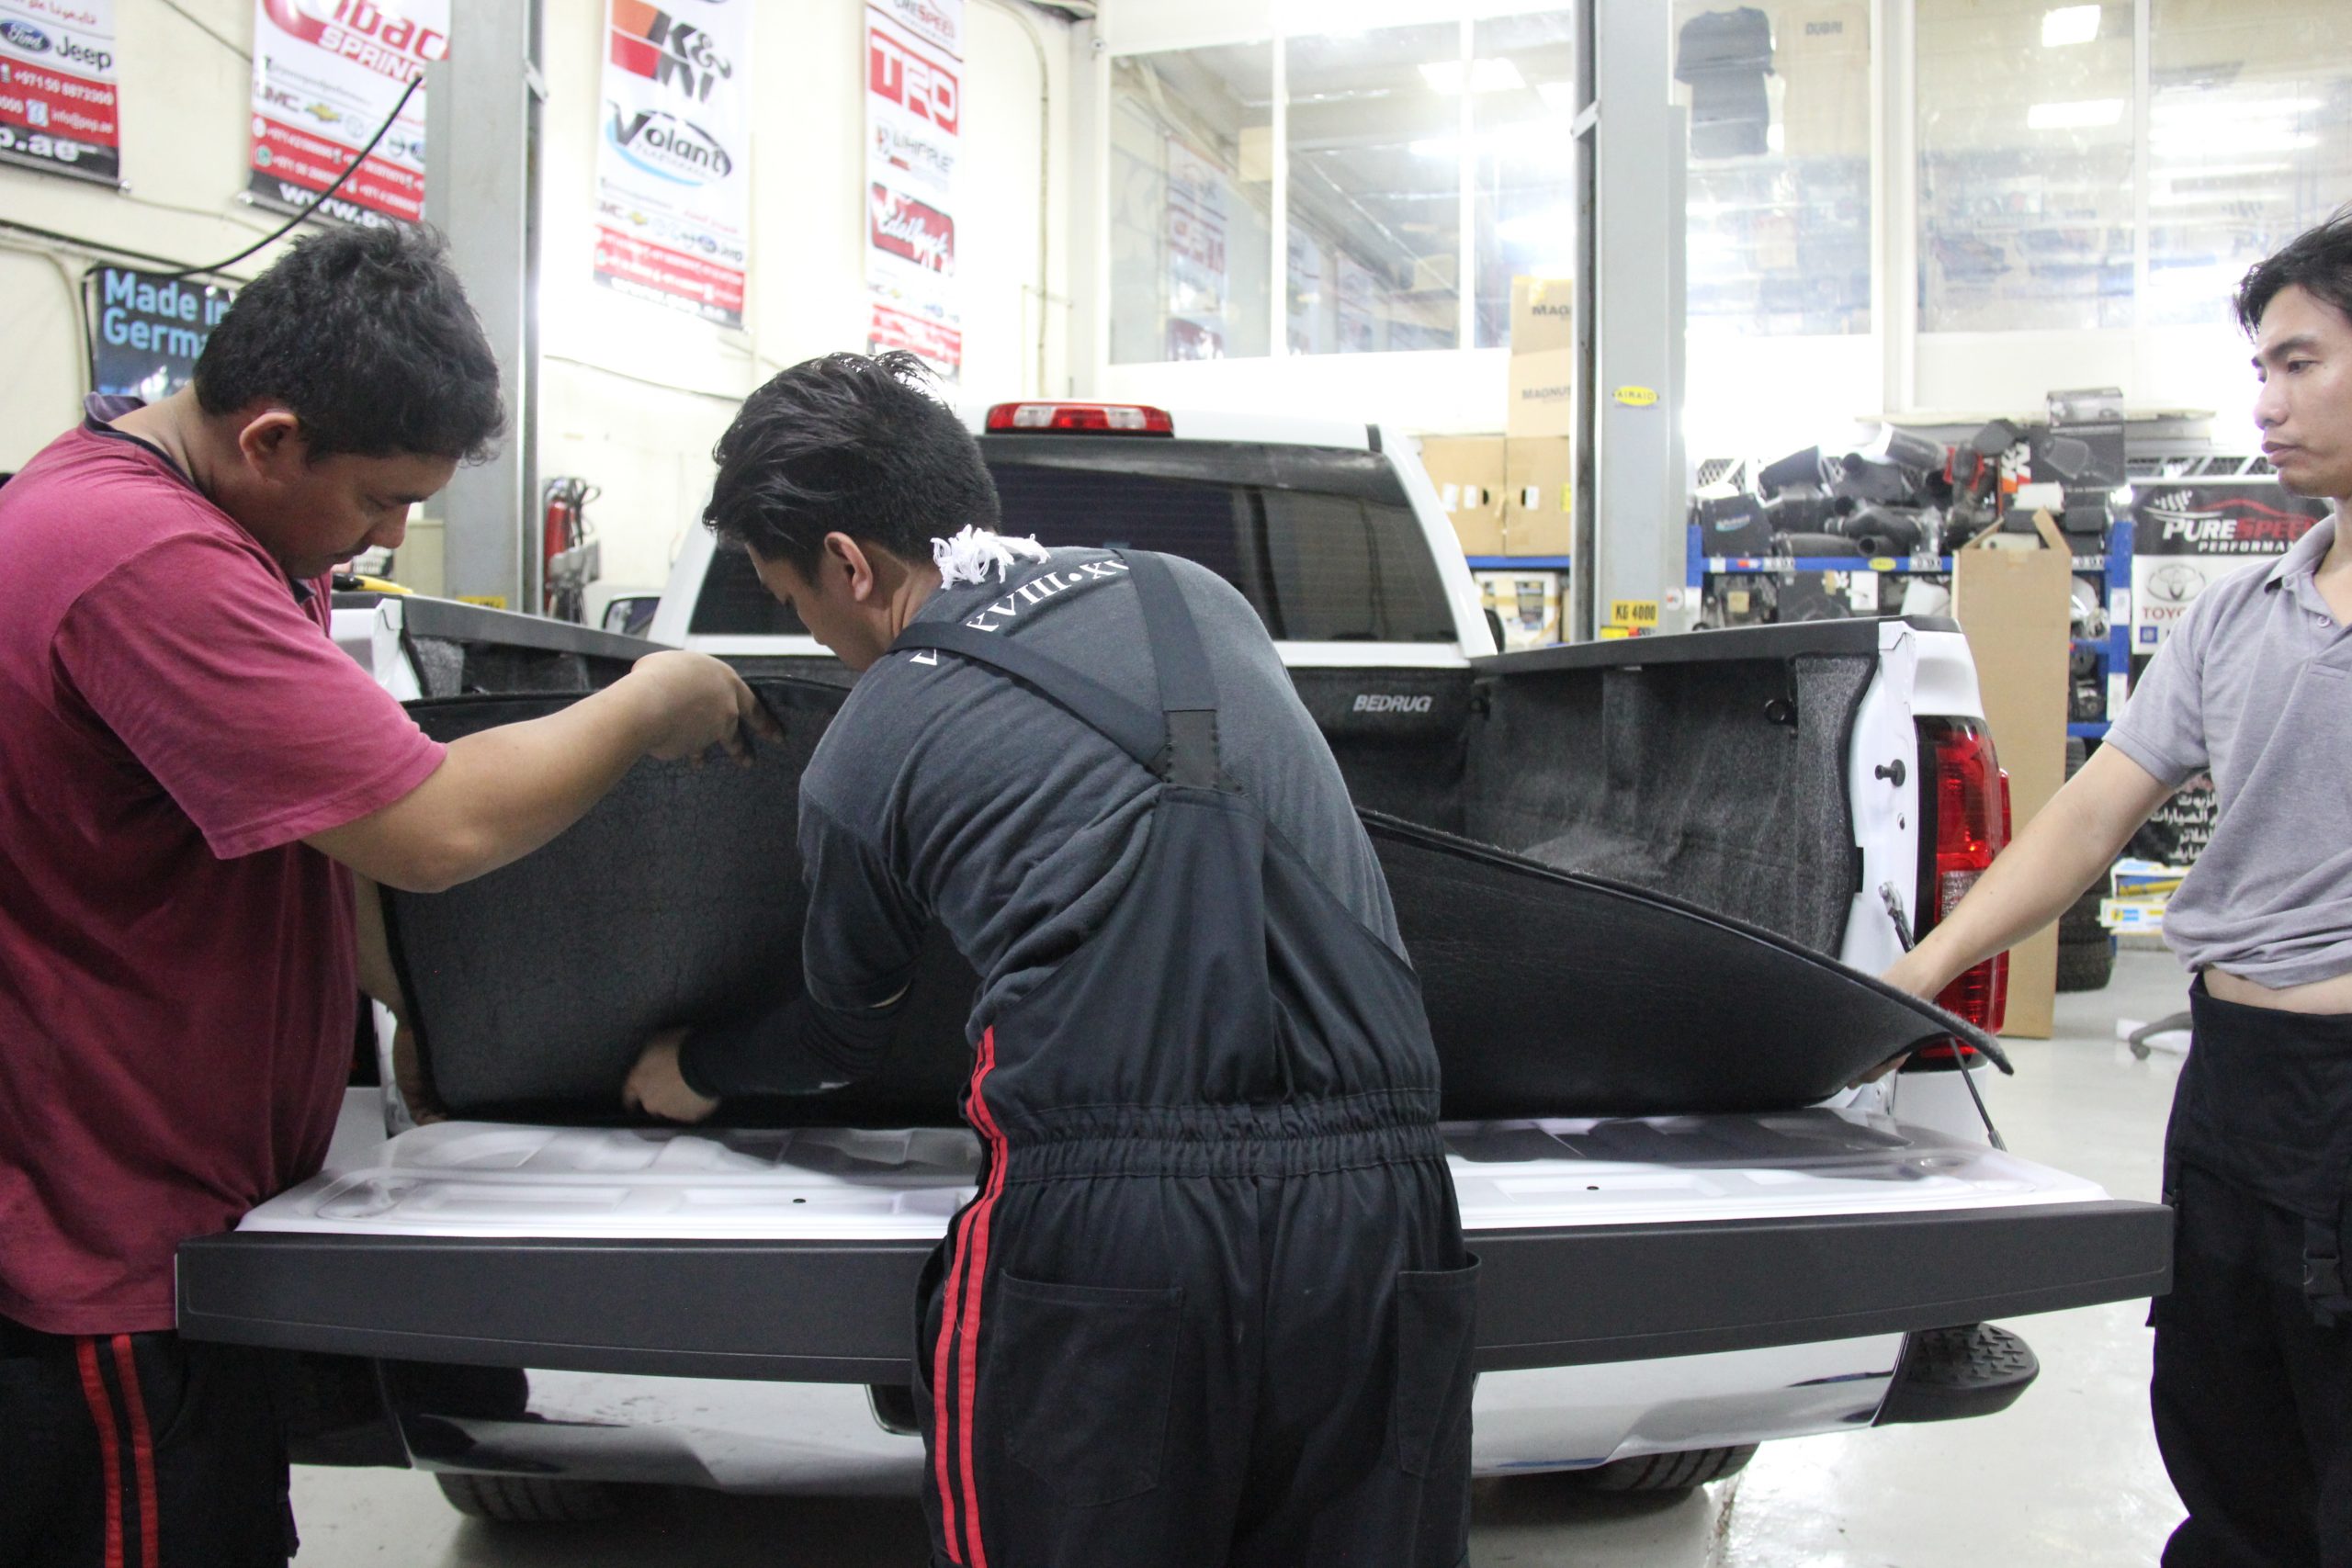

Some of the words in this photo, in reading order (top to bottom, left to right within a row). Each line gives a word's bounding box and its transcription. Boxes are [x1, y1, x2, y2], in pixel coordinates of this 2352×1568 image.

[55, 36, 112, 72] Jeep
[870, 33, 956, 129] TRD
[605, 98, 722, 173] Volant
[105, 268, 198, 321] Made
[103, 307, 209, 360] Germ
[1615, 604, 1628, 620] KG
[1632, 604, 1657, 621] 4000
[1352, 694, 1432, 713] BEDRUG
